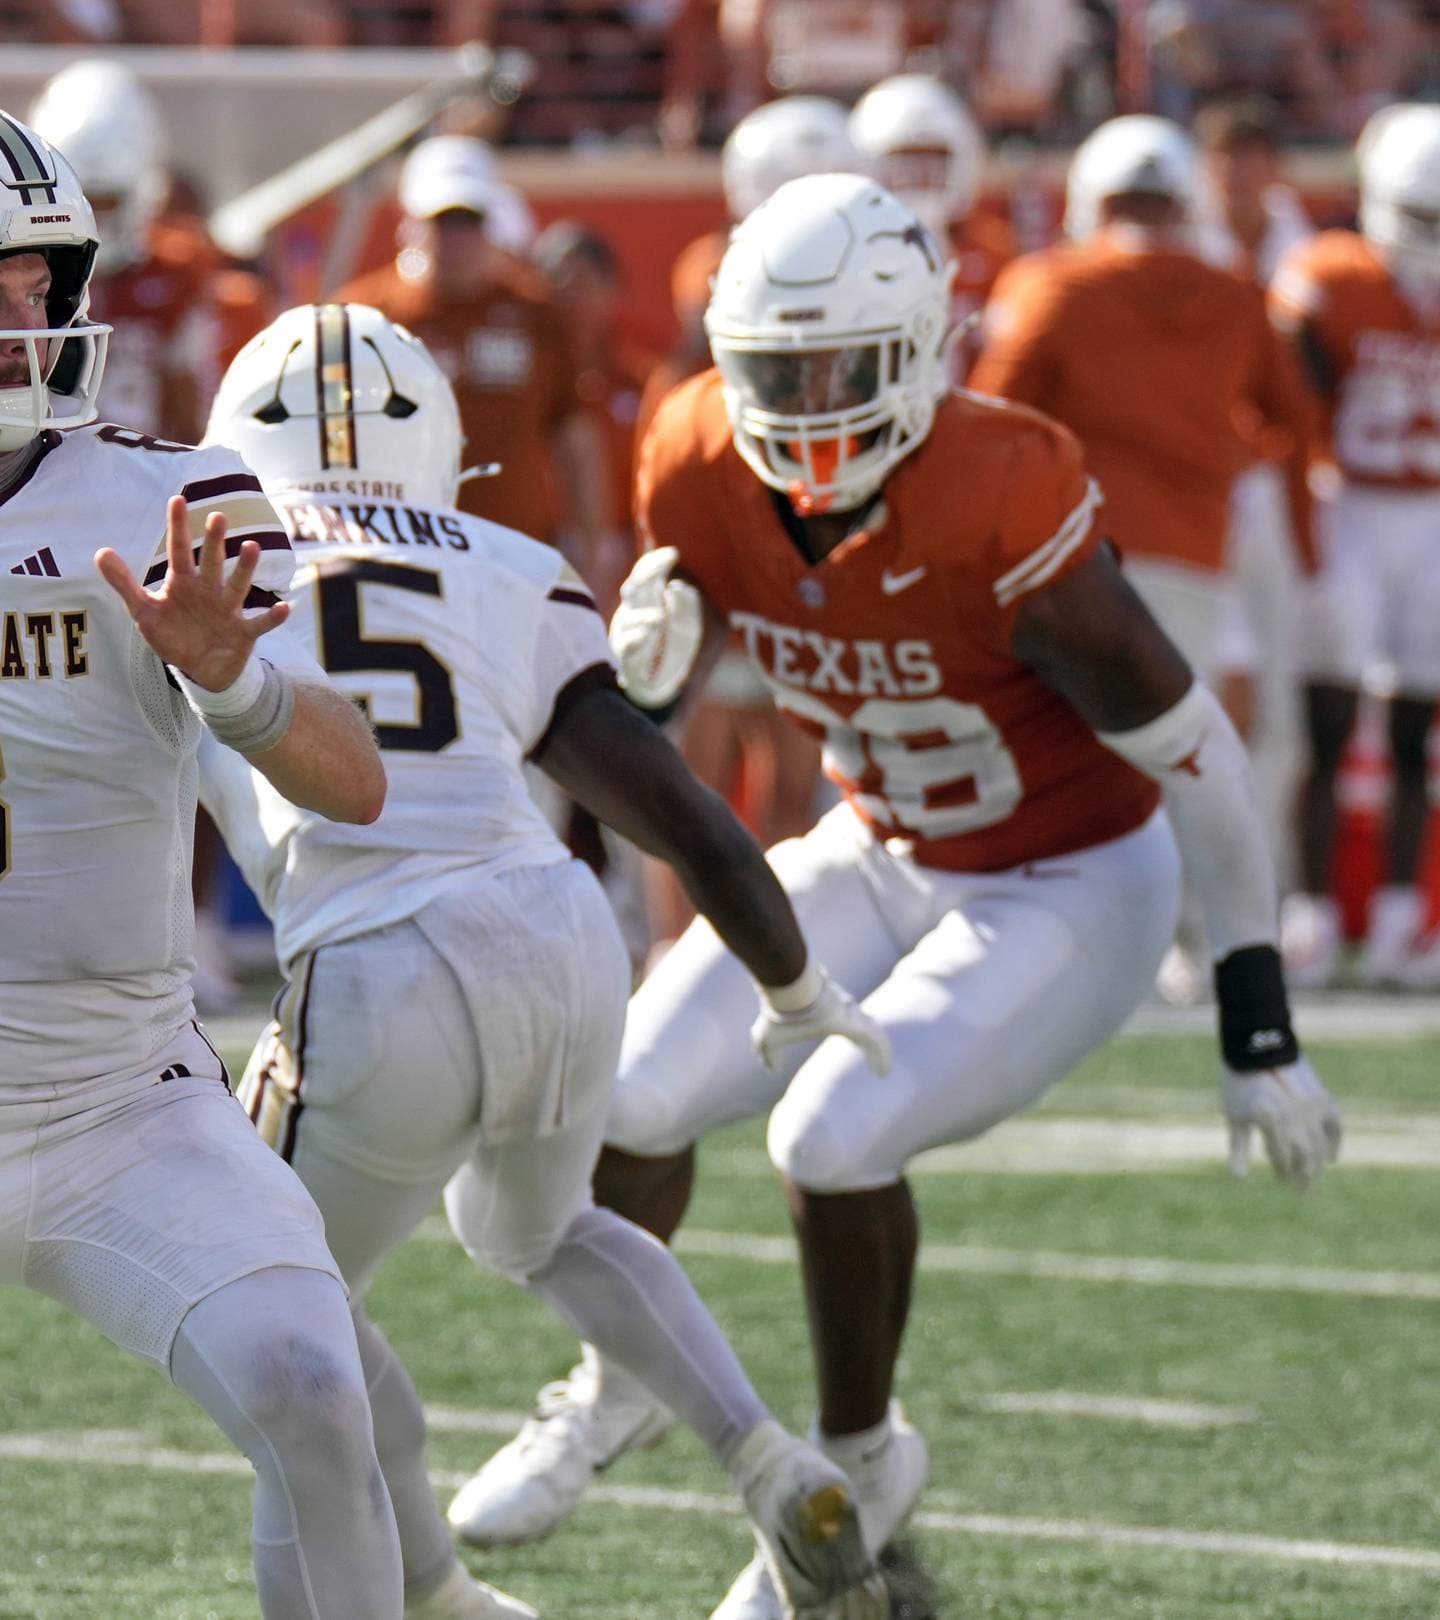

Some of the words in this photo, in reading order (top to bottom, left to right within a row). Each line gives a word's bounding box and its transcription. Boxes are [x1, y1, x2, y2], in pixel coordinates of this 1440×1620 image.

[30, 214, 71, 225] BOBCATS
[284, 503, 470, 551] ENKINS
[312, 556, 464, 752] 5
[728, 609, 942, 697] TEXAS
